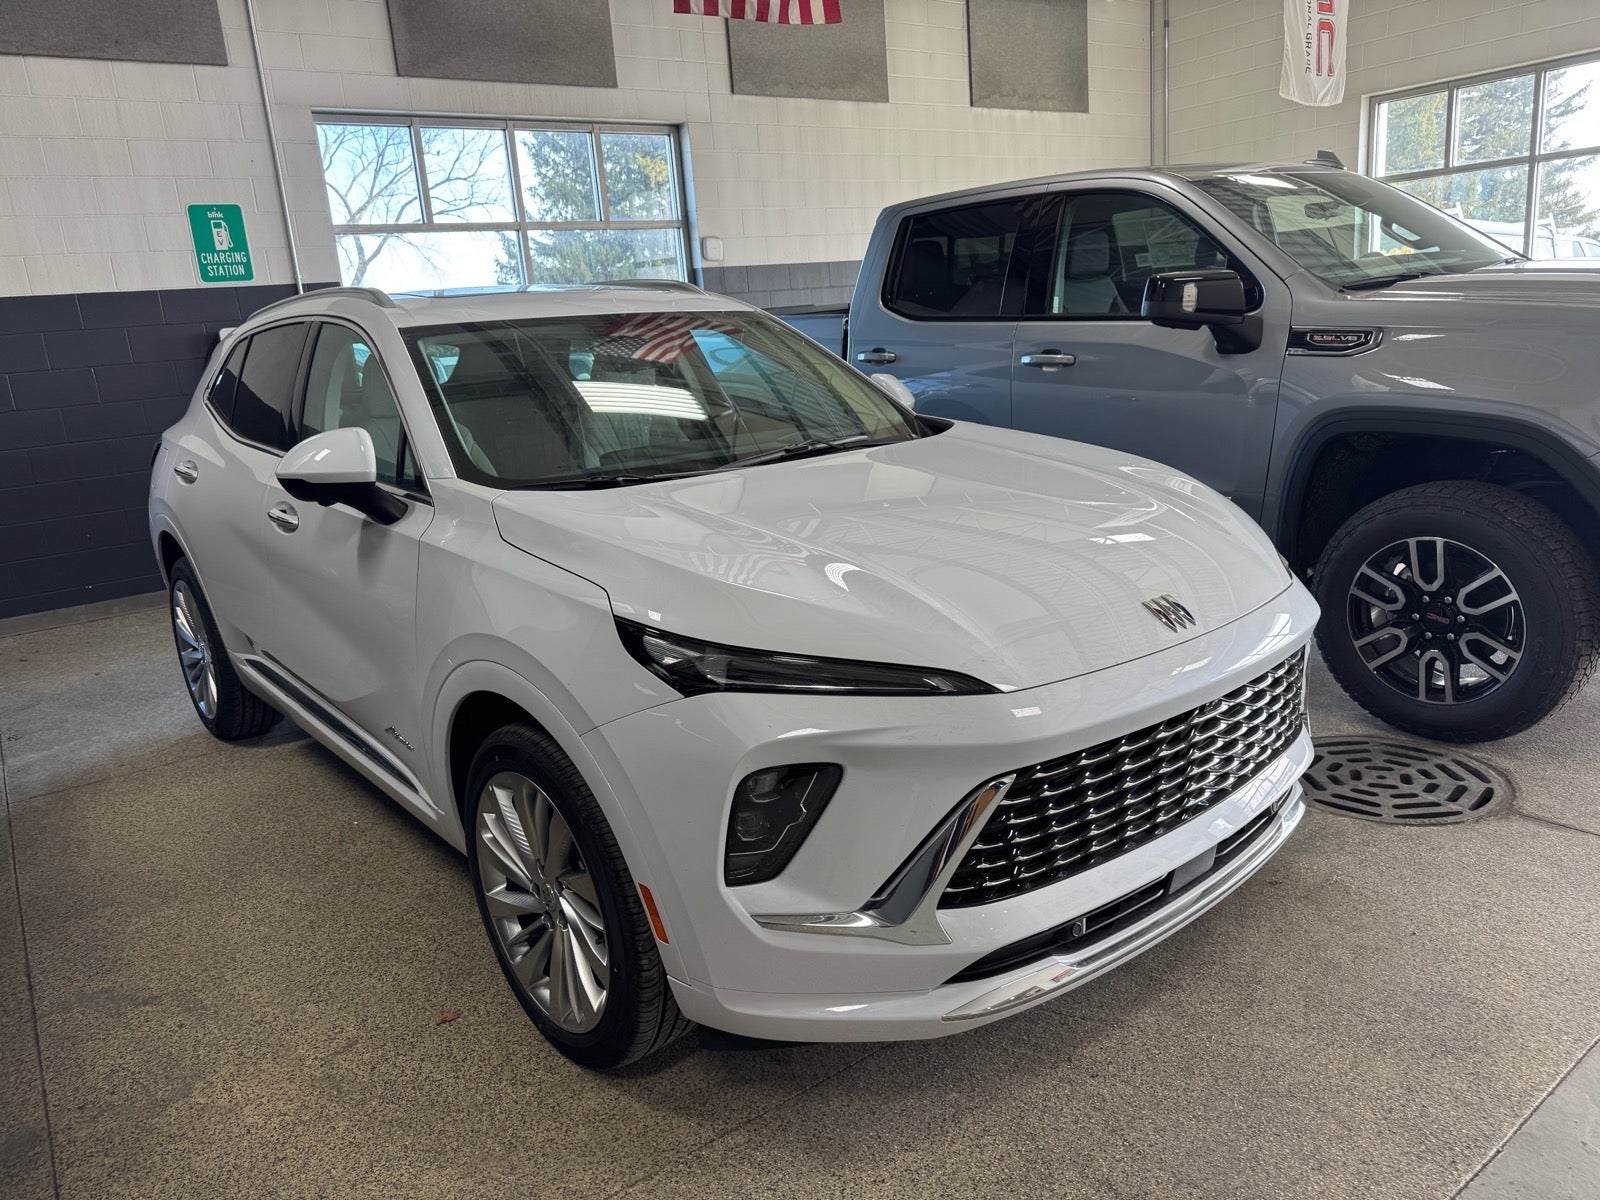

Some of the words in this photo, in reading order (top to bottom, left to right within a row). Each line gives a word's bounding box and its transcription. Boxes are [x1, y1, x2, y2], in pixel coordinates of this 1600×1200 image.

[207, 208, 224, 218] blink
[200, 252, 247, 264] CHARGING
[207, 265, 246, 277] STATION
